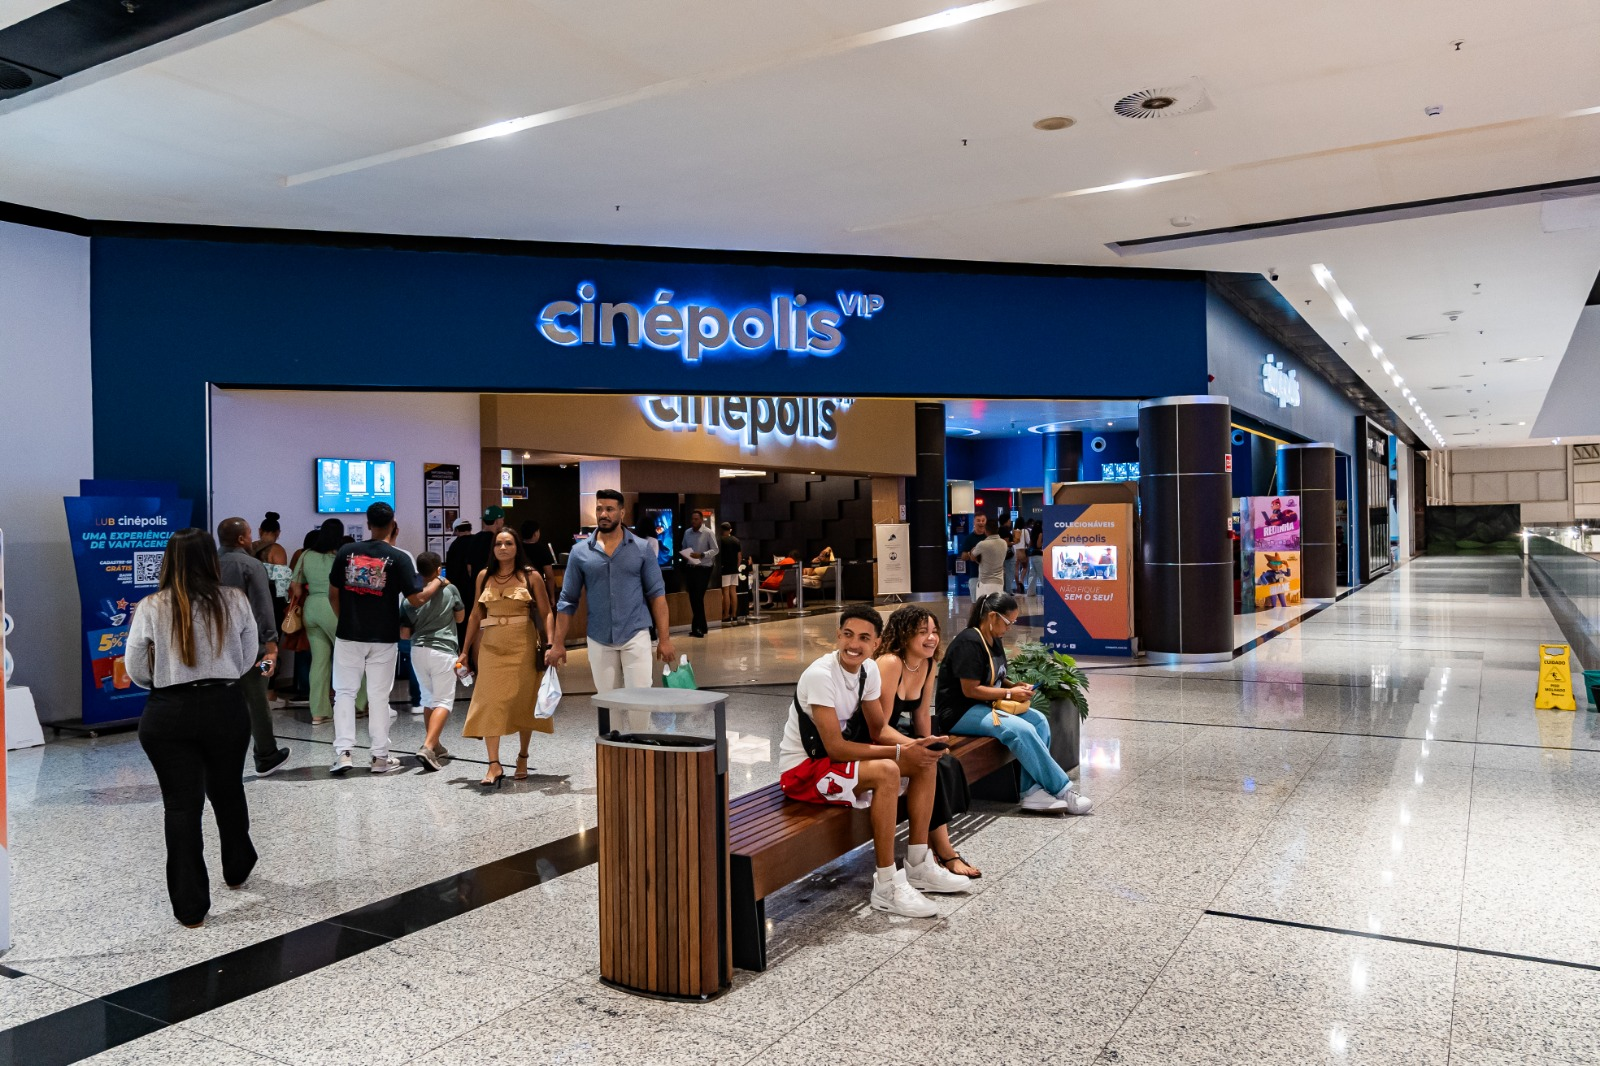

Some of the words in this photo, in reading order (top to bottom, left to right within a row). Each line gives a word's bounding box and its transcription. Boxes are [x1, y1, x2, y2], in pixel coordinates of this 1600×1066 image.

[538, 282, 843, 361] cinépolis
[839, 293, 884, 317] VIP
[118, 515, 168, 527] cinépolis
[1054, 520, 1115, 528] COLECIONÁVEIS
[82, 532, 107, 540] UMA
[1061, 534, 1106, 544] cinépolis
[90, 541, 106, 549] DE
[108, 540, 169, 548] VANTAGENS
[1093, 593, 1114, 601] SEU!
